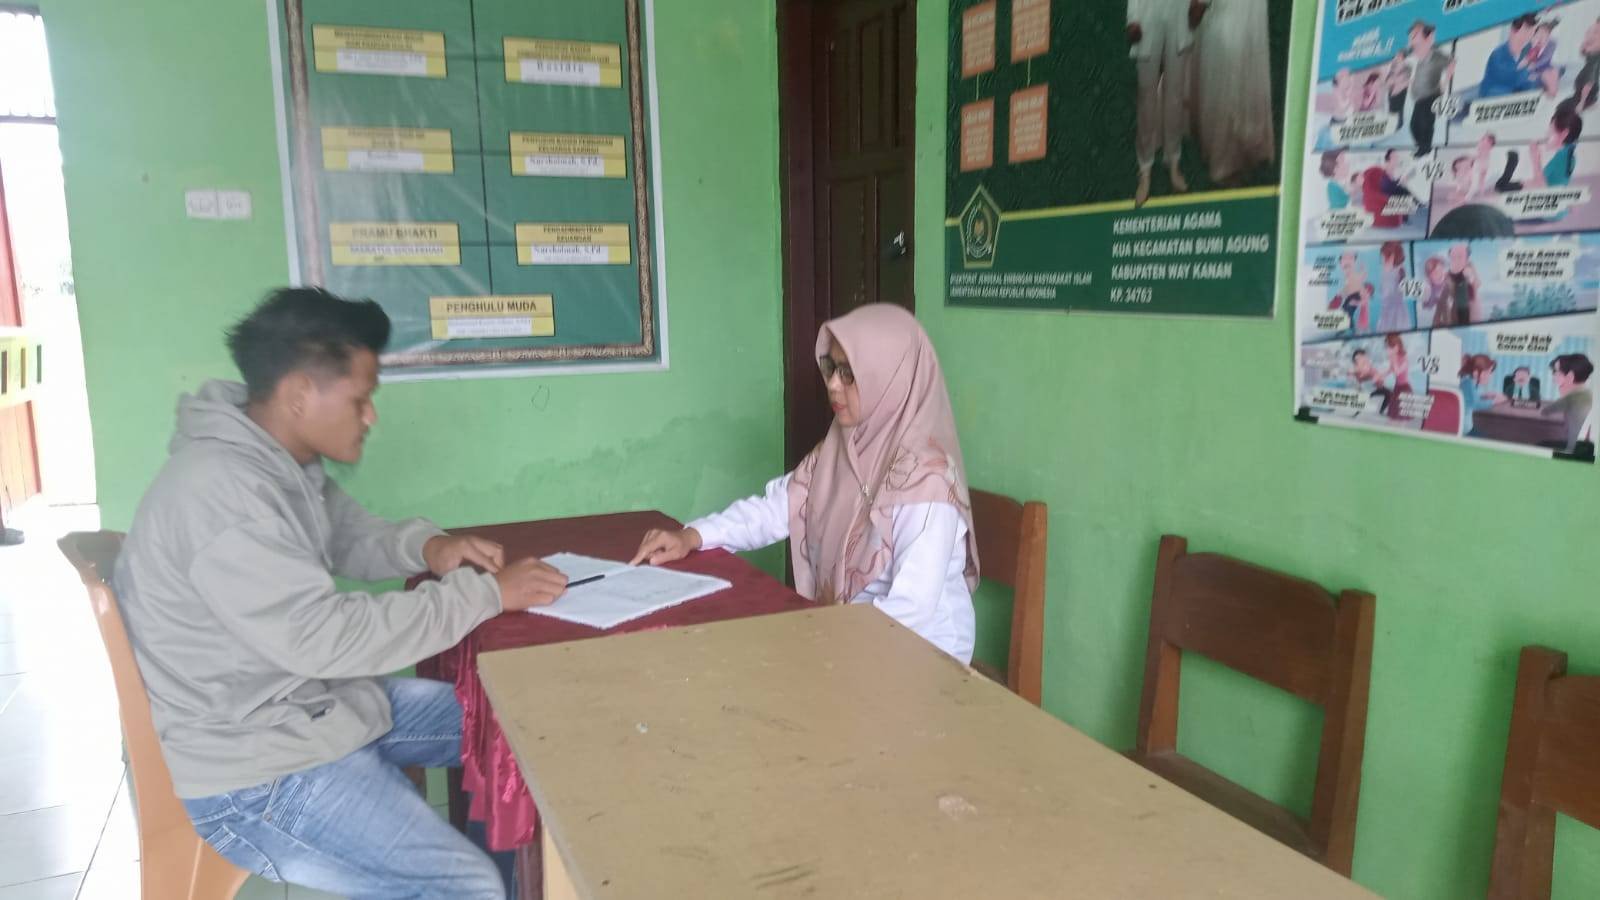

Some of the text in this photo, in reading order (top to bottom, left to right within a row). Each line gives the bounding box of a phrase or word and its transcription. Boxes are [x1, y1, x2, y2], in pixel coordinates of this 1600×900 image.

[1113, 211, 1222, 235] KEMENTERIAN AGAMA
[395, 228, 438, 239] BHAKTI
[1112, 233, 1269, 258] KUA KECAMATAN BUMI AGUNG
[1112, 262, 1232, 280] KABUPATEN WAY KANAN
[446, 301, 537, 313] PENGHULU MUDA
[1417, 356, 1440, 375] VS
